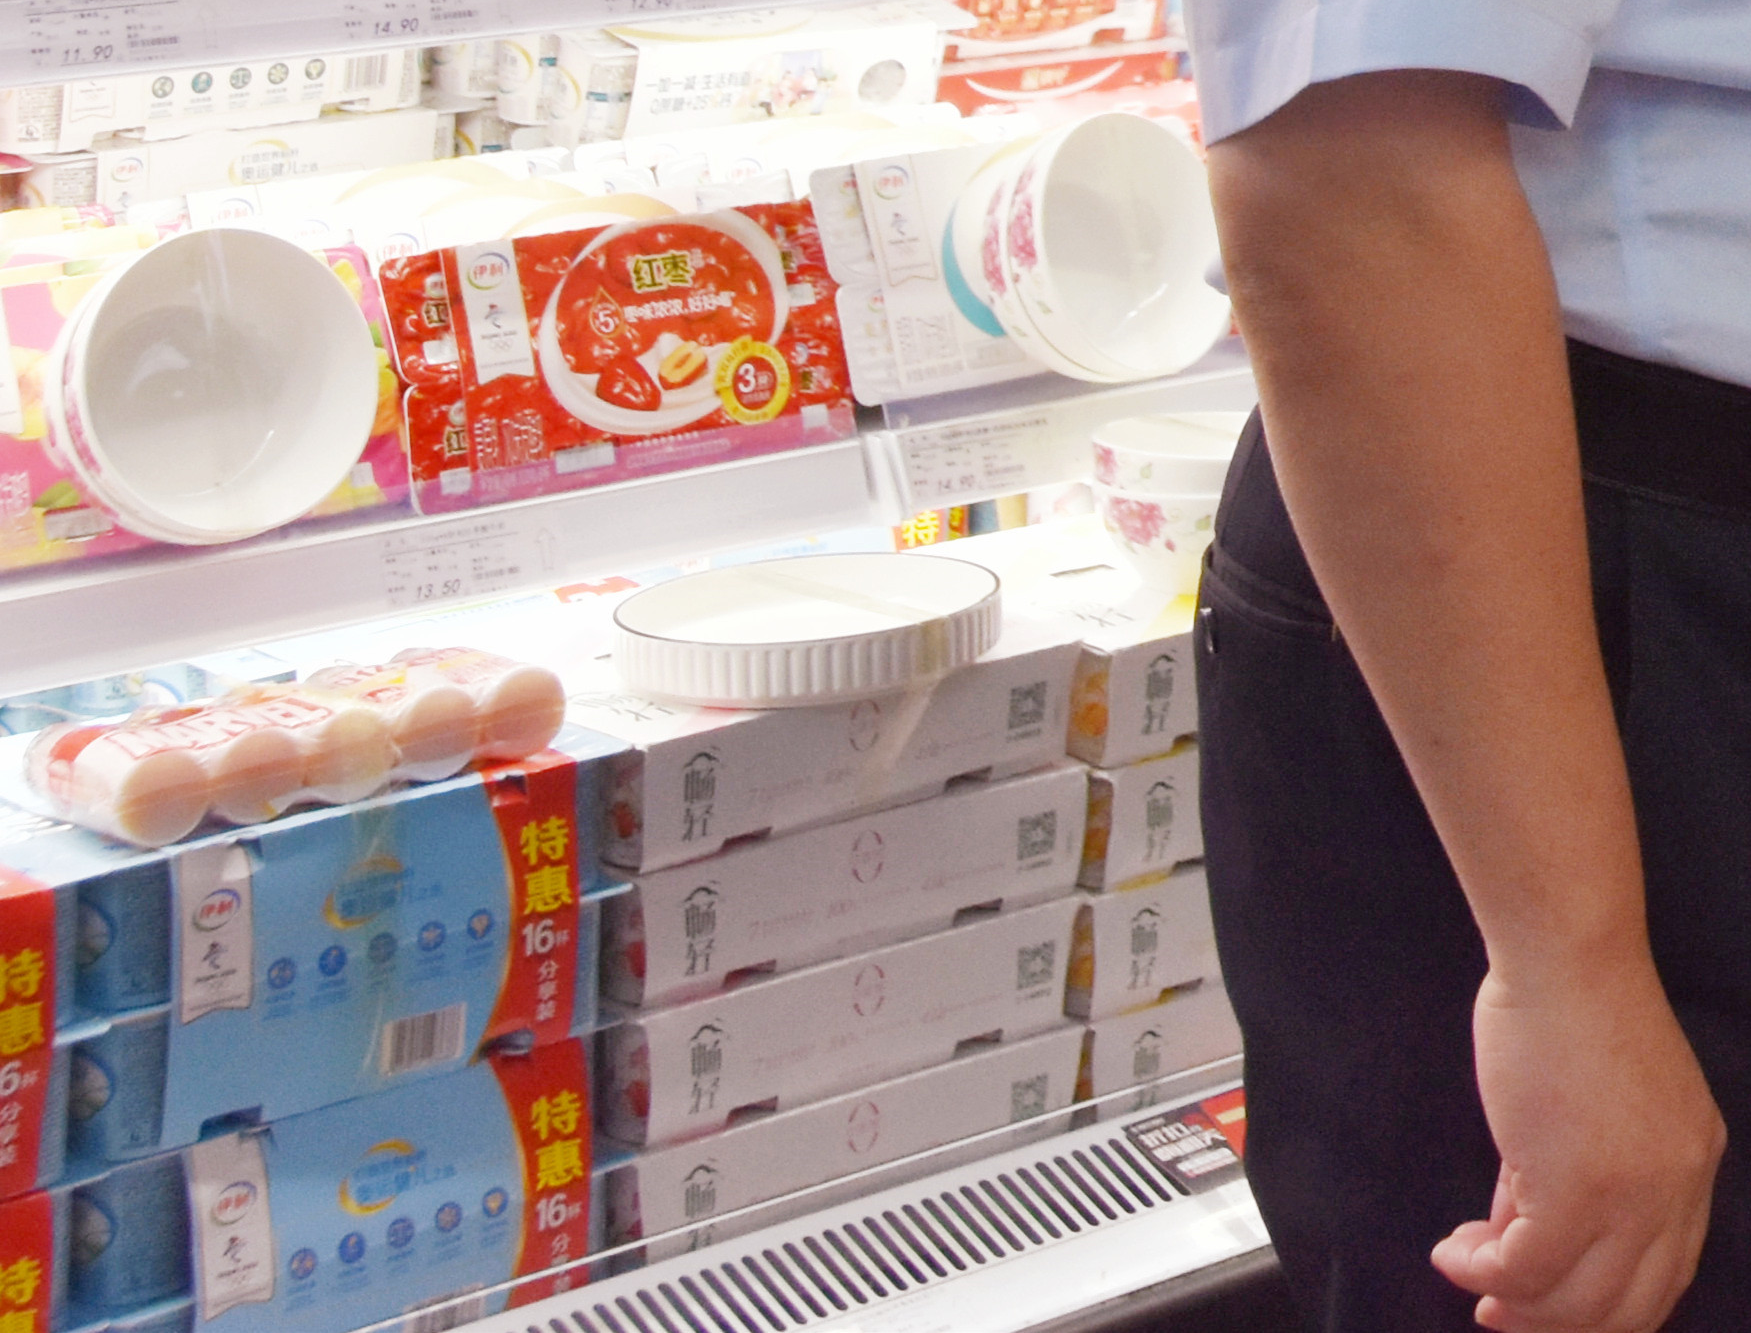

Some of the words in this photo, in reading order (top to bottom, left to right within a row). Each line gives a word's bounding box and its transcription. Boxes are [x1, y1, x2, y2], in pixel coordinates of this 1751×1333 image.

[631, 251, 695, 292] 红枣
[520, 817, 572, 916] 特惠
[530, 1089, 585, 1191] 特惠
